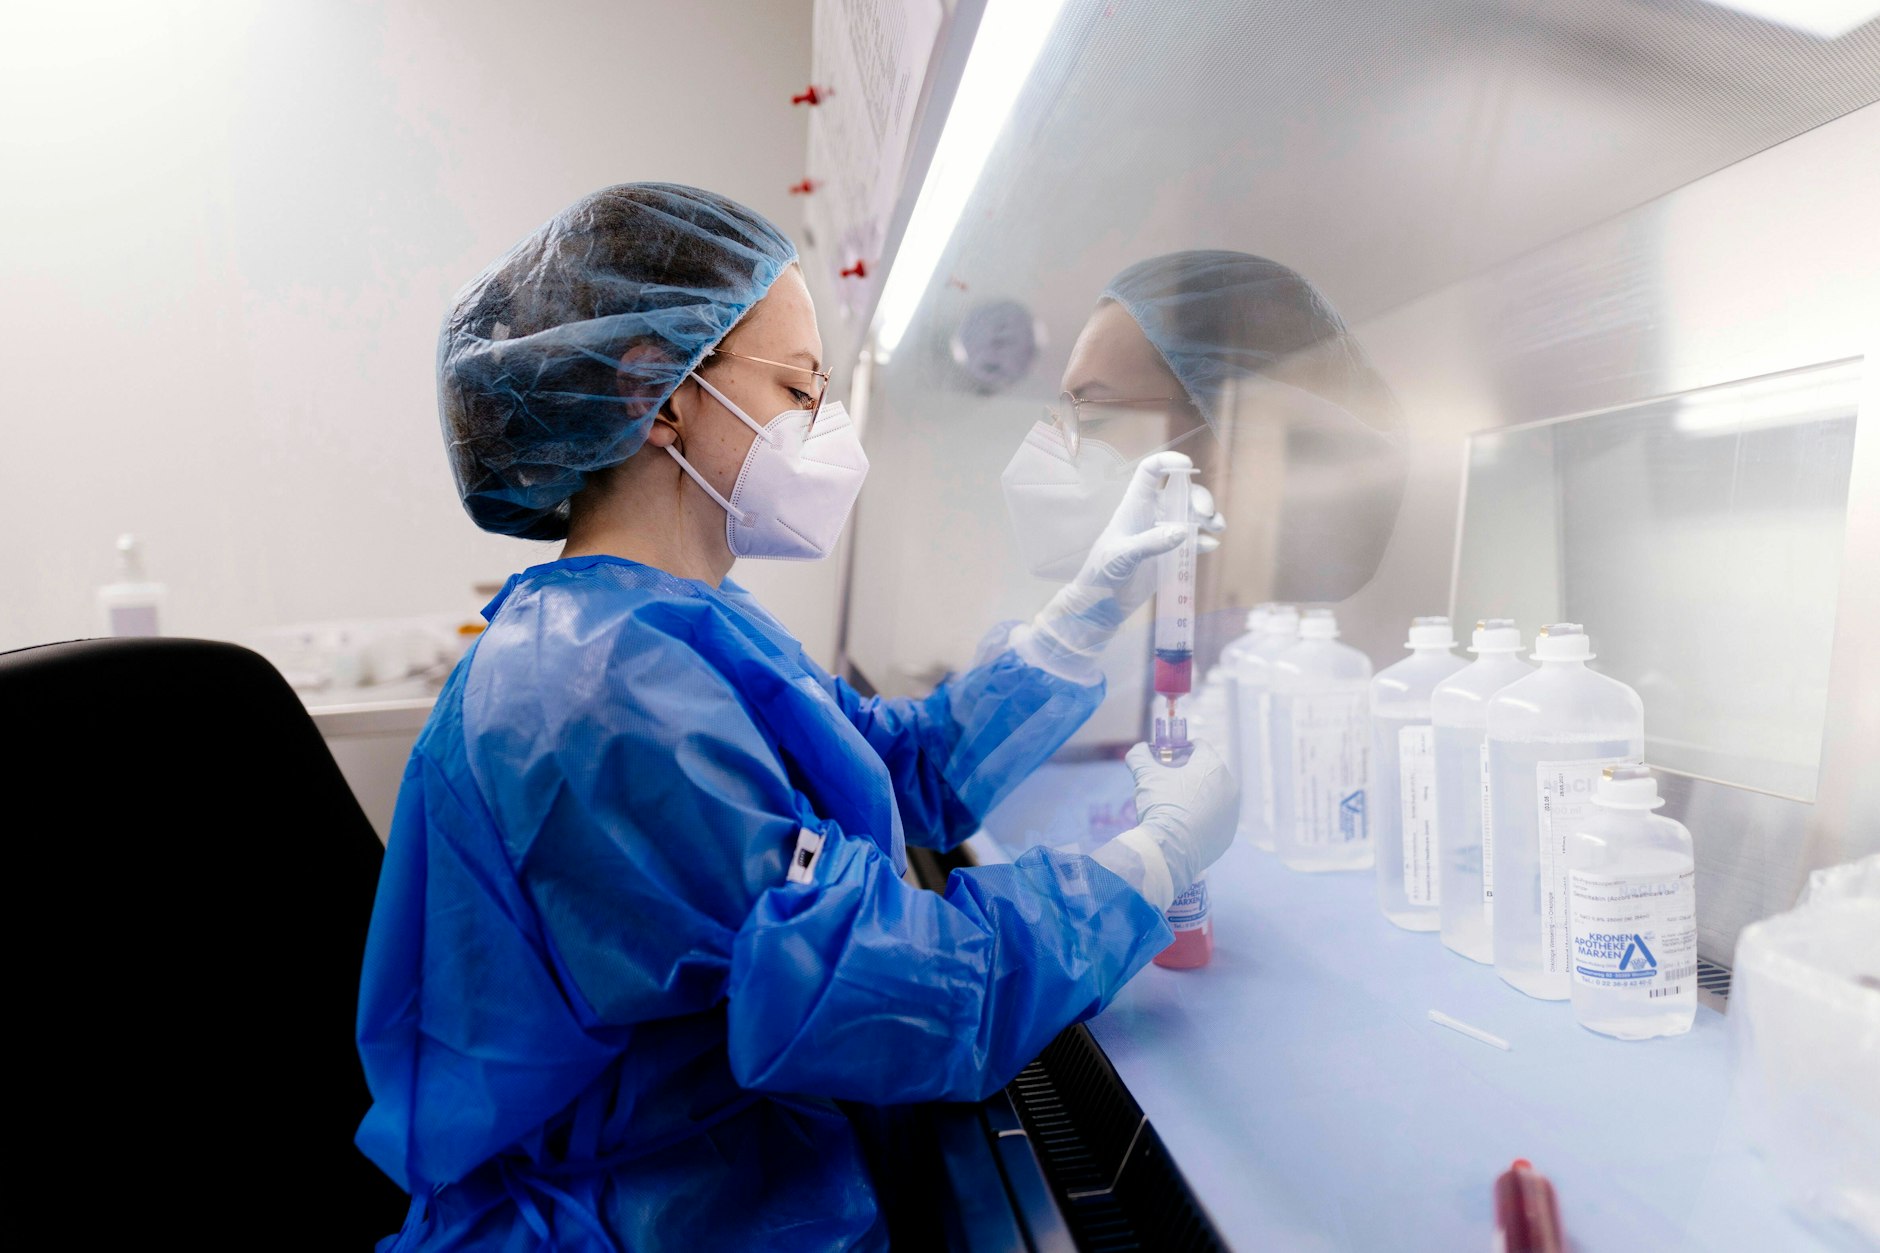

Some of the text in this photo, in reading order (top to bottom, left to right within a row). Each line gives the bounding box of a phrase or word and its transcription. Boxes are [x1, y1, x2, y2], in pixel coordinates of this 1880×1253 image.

[1177, 595, 1188, 605] 40
[1177, 618, 1187, 628] 30
[1589, 932, 1633, 942] KRONEN
[1574, 937, 1626, 951] APOTHEKE
[1578, 946, 1622, 960] MARXEN
